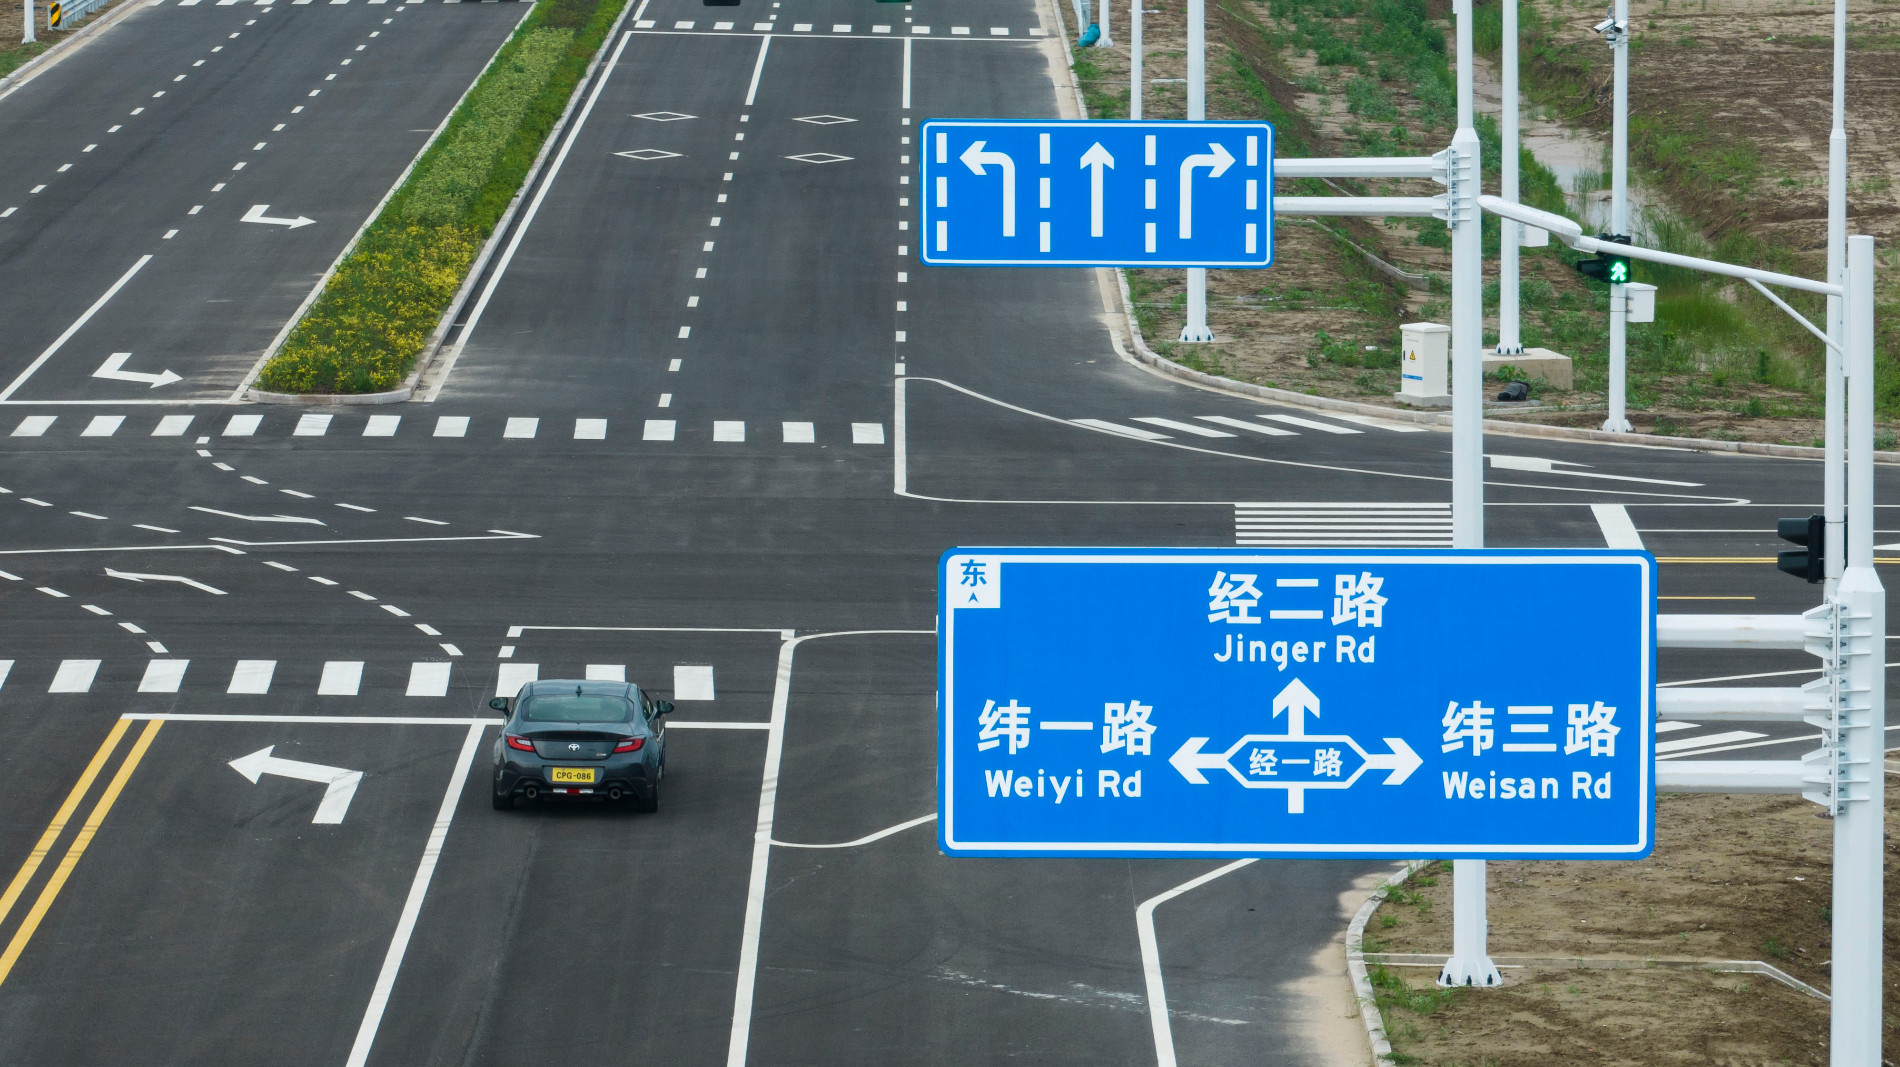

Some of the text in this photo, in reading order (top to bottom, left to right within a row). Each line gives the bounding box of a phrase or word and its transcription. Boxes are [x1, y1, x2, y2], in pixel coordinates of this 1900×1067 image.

[961, 559, 987, 587] 东
[1208, 571, 1388, 627] 经二路
[1214, 634, 1375, 671] Jinger Rd
[978, 700, 1157, 755] 纬一路
[1441, 701, 1621, 757] 纬三路
[556, 771, 592, 780] CPG-086
[1249, 748, 1343, 776] 经一路
[985, 769, 1142, 803] Weiyi Rd
[1442, 771, 1611, 799] Weisan Rd
